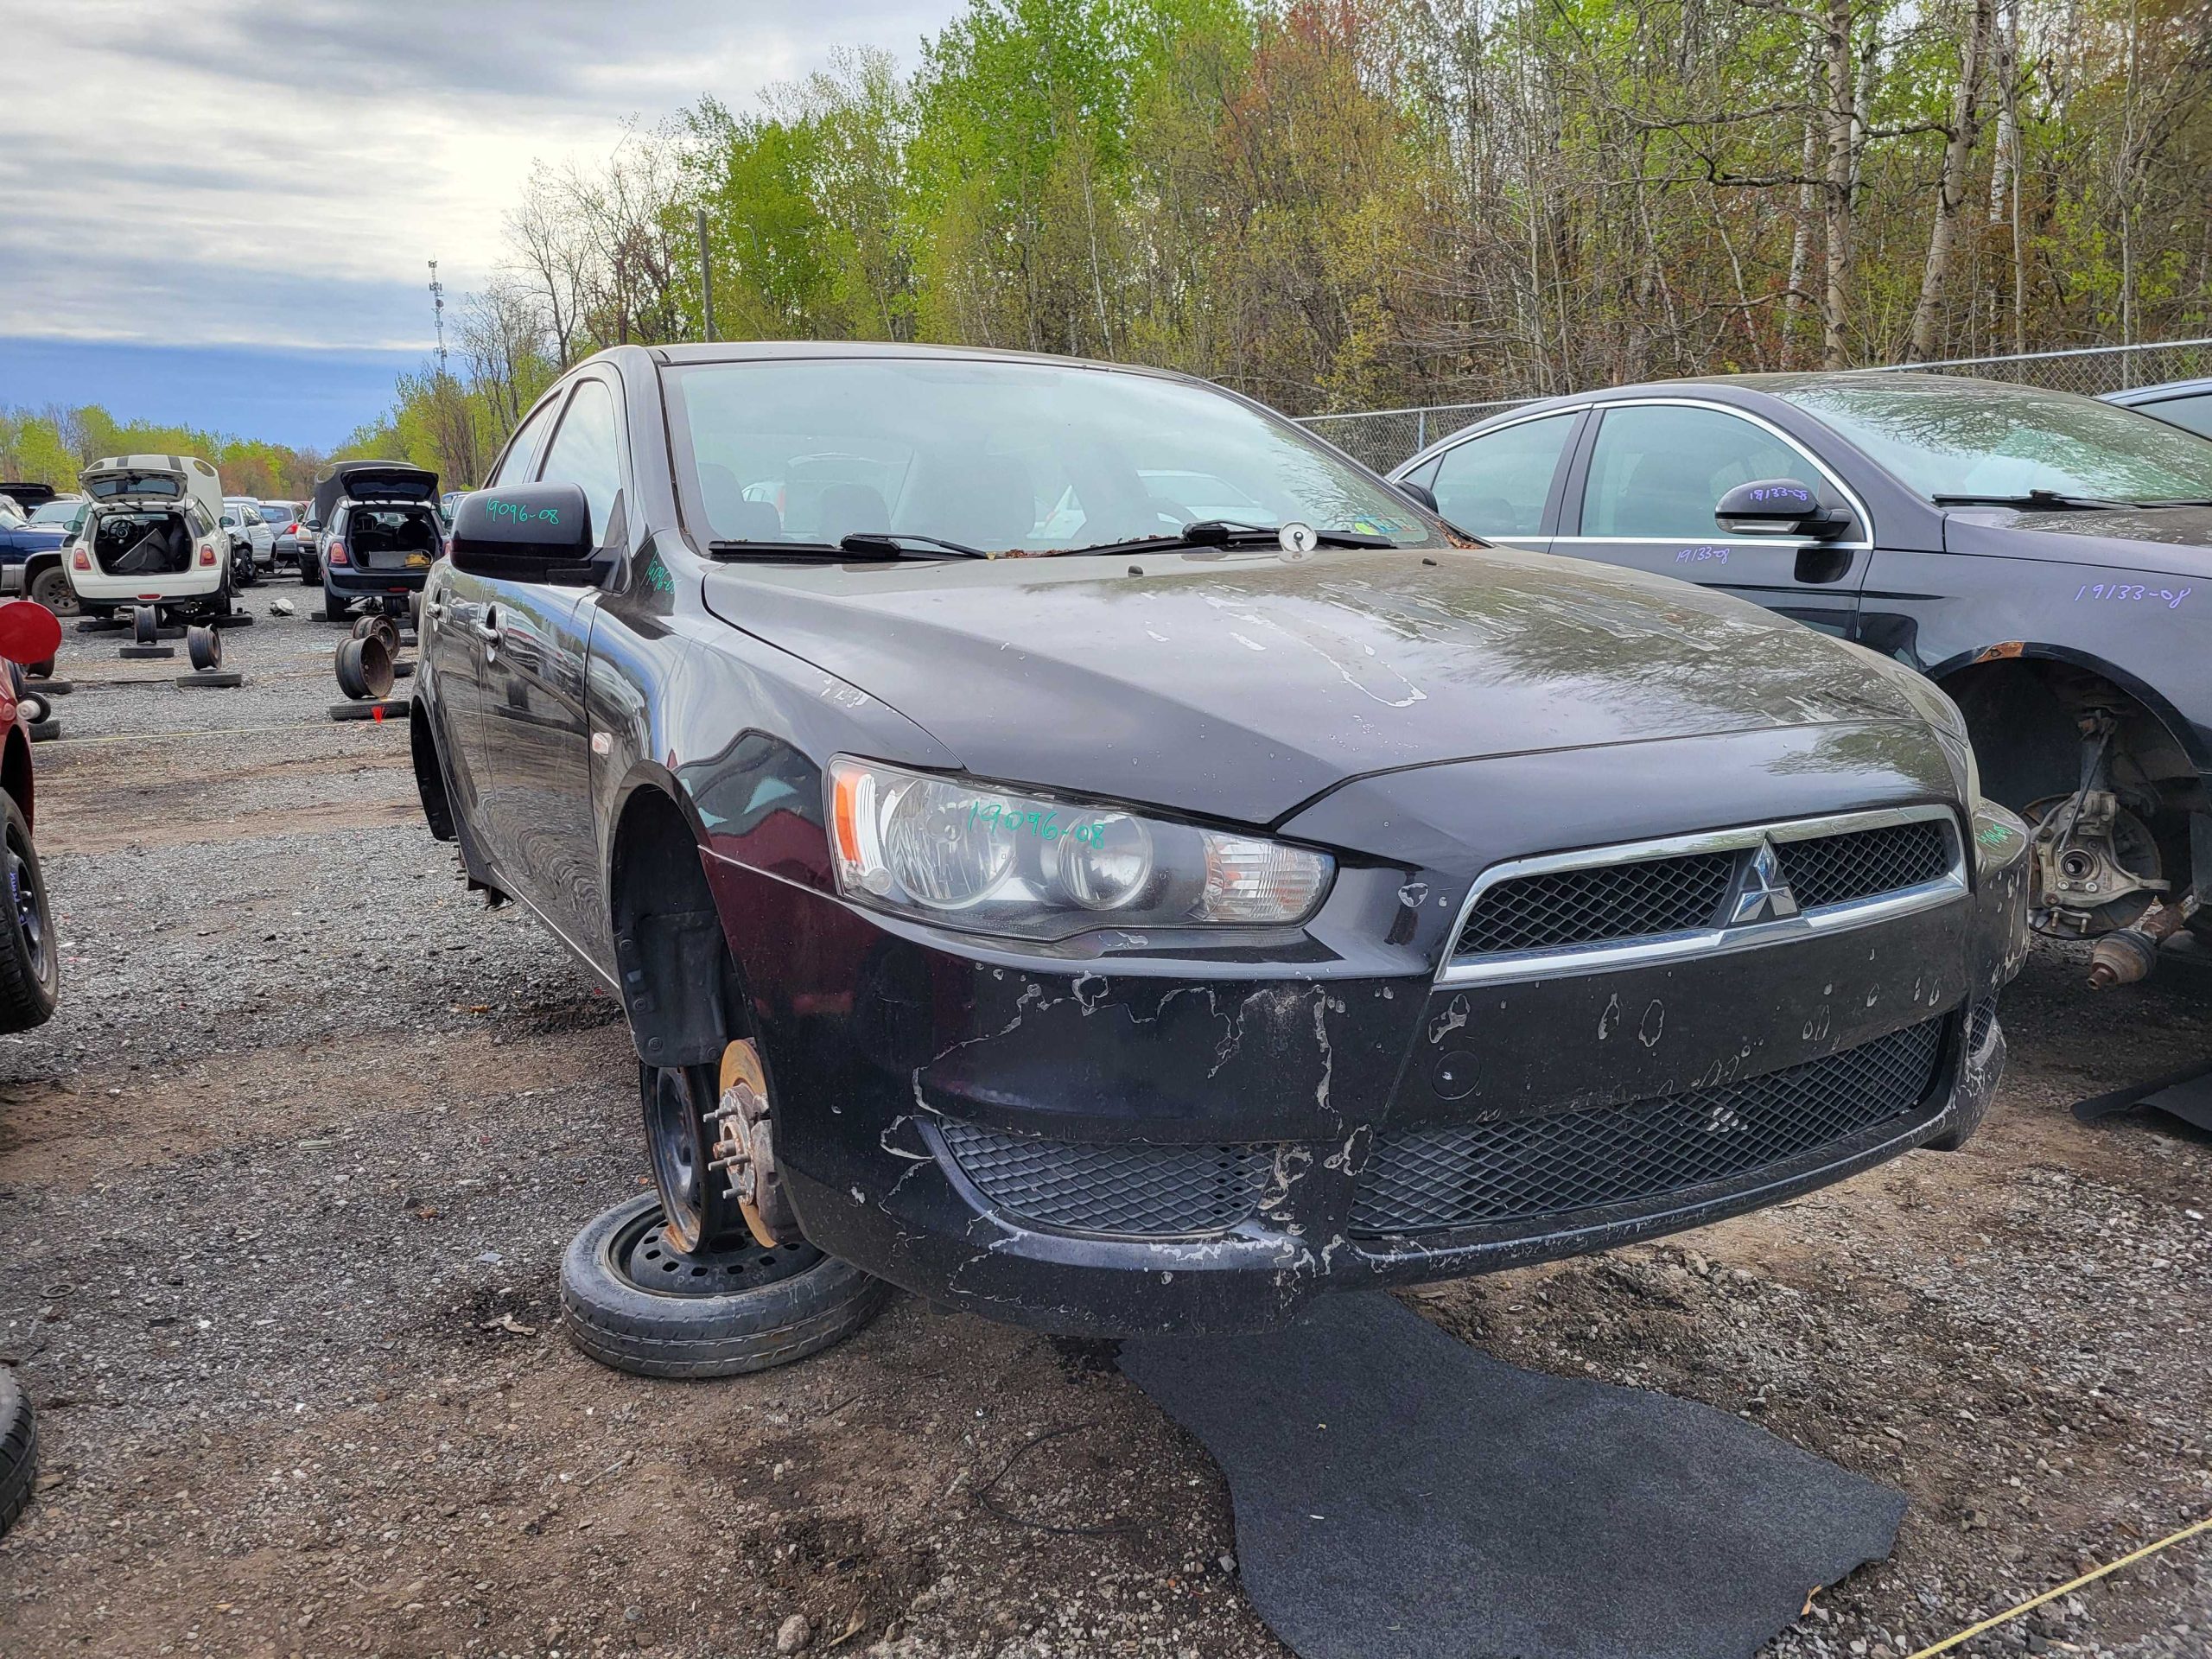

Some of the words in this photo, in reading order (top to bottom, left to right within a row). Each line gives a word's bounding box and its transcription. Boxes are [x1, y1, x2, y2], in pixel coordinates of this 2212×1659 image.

[486, 497, 559, 524] 19096-08
[1675, 546, 1730, 564] 19133-08
[2075, 584, 2191, 608] 19133-08
[968, 801, 1105, 849] 19096-08
